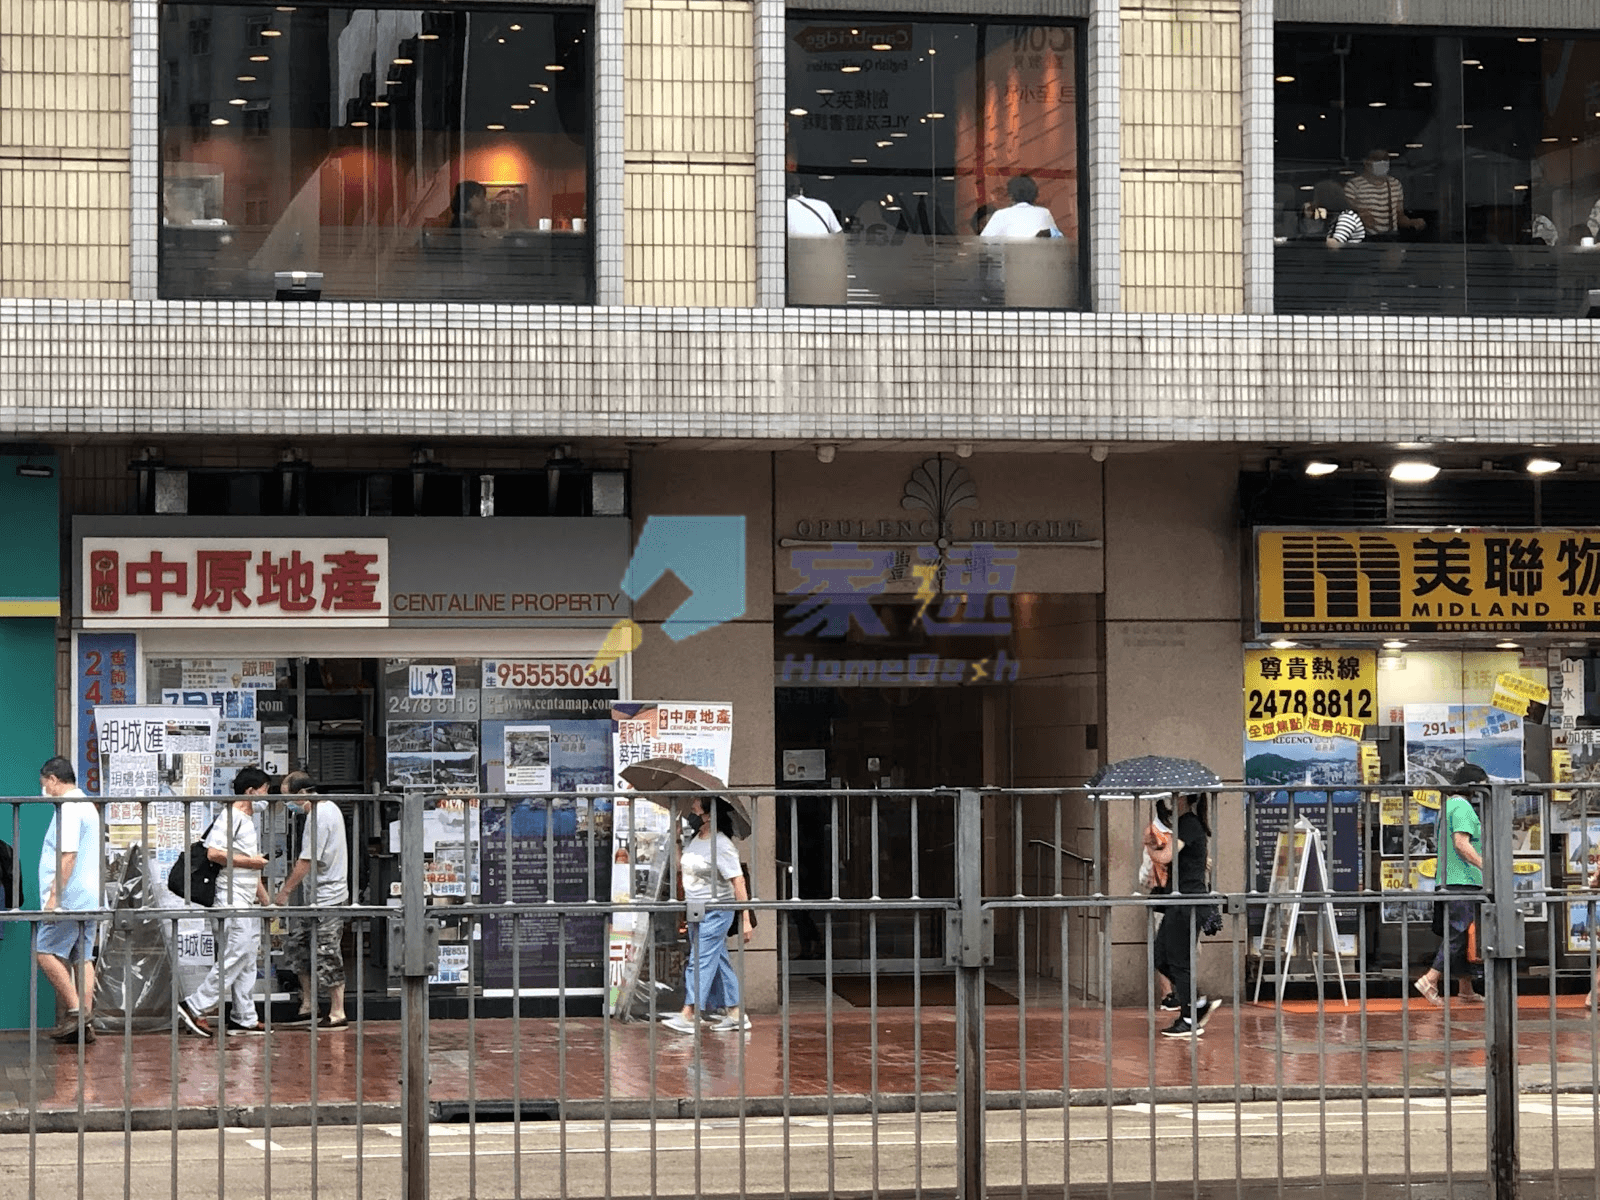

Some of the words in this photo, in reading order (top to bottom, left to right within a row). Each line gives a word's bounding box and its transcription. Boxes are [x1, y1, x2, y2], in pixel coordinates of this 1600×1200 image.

[797, 520, 953, 538] OPULENCE
[972, 520, 1084, 538] HEIGHT
[1411, 537, 1600, 597] 美聯物
[125, 550, 382, 612] 中原地產
[393, 592, 505, 612] CENTALINE
[510, 592, 621, 613] PROPERTY
[1411, 602, 1550, 617] MIDLAND
[497, 663, 613, 688] 95555034
[1260, 656, 1361, 681] 尊貴熱線
[410, 667, 455, 697] 山水盈
[388, 696, 432, 714] 2478
[1249, 689, 1308, 719] 2478
[1313, 689, 1373, 718] 8812
[670, 709, 731, 725] 中原地產
